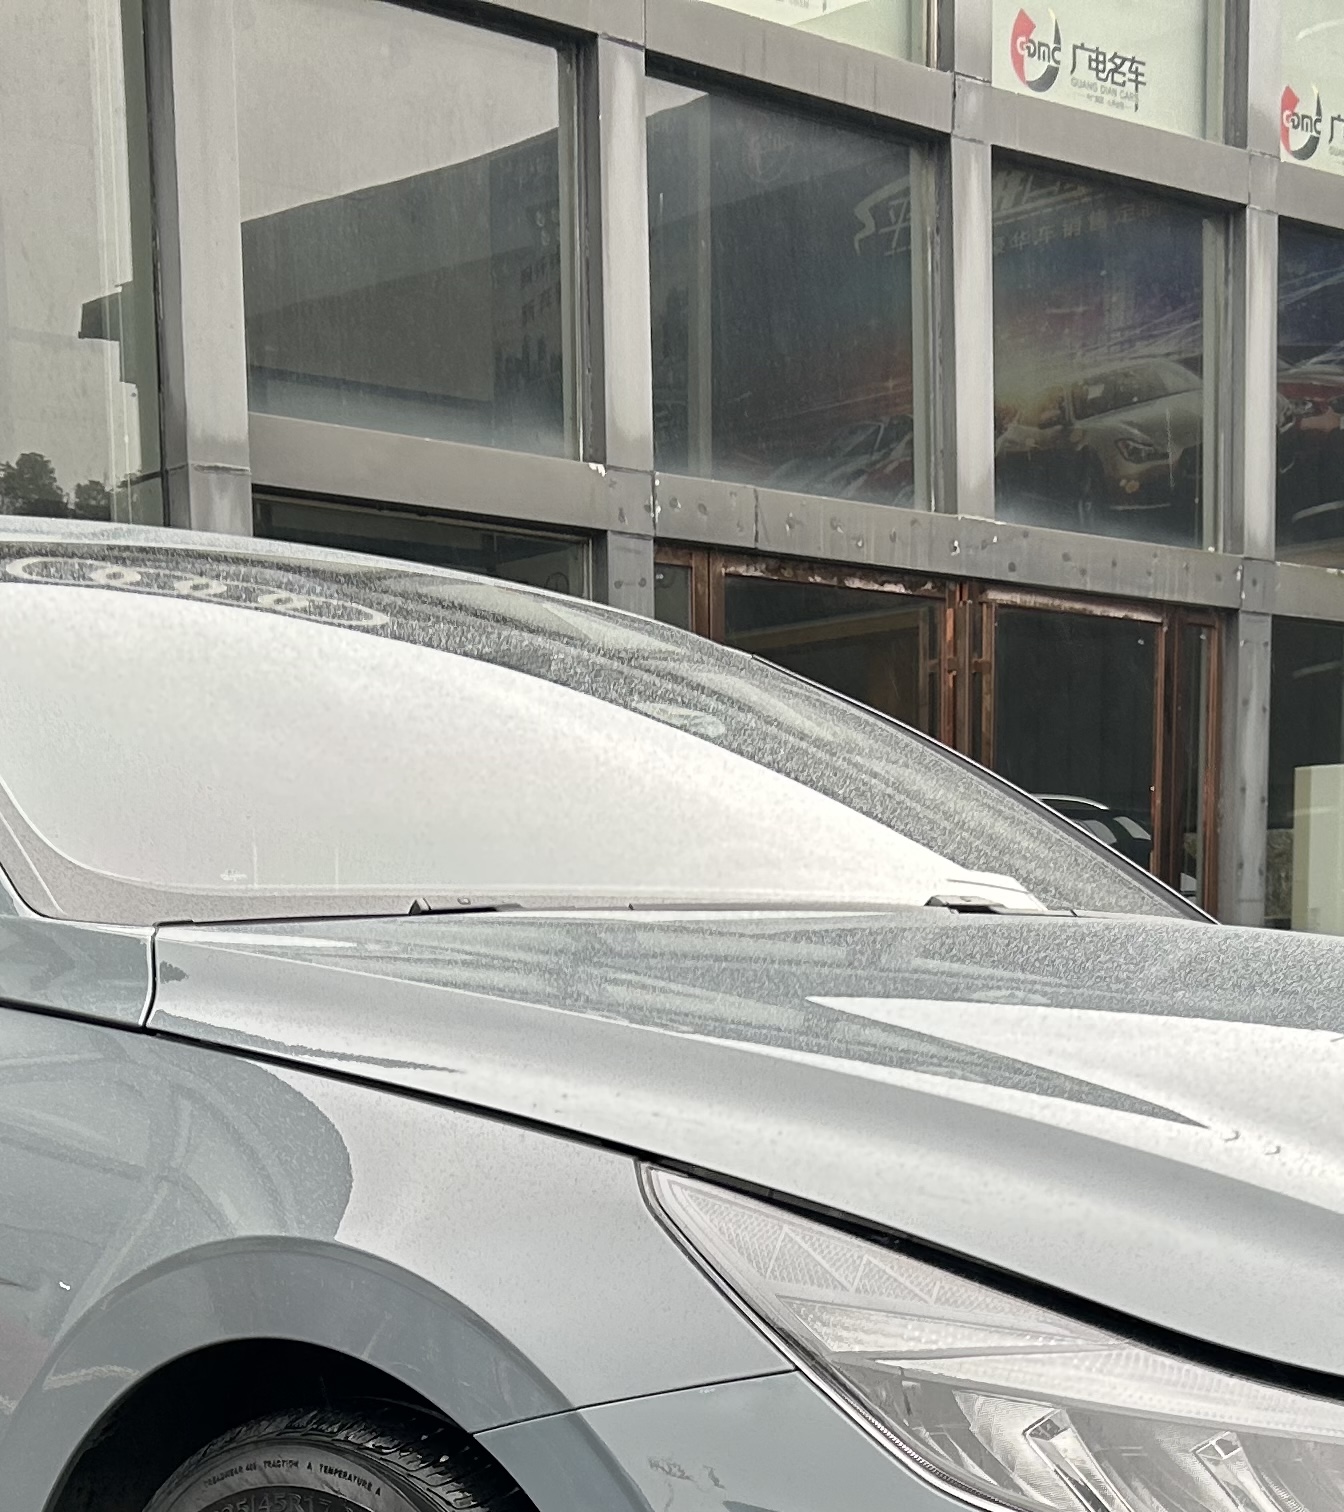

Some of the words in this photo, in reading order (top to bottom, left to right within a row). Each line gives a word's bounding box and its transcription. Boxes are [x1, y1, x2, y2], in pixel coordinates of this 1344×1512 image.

[1070, 41, 1148, 113] 广电名车
[263, 1459, 300, 1470] TRACTION
[306, 1461, 313, 1472] A
[319, 1464, 374, 1492] TEMPERATURE
